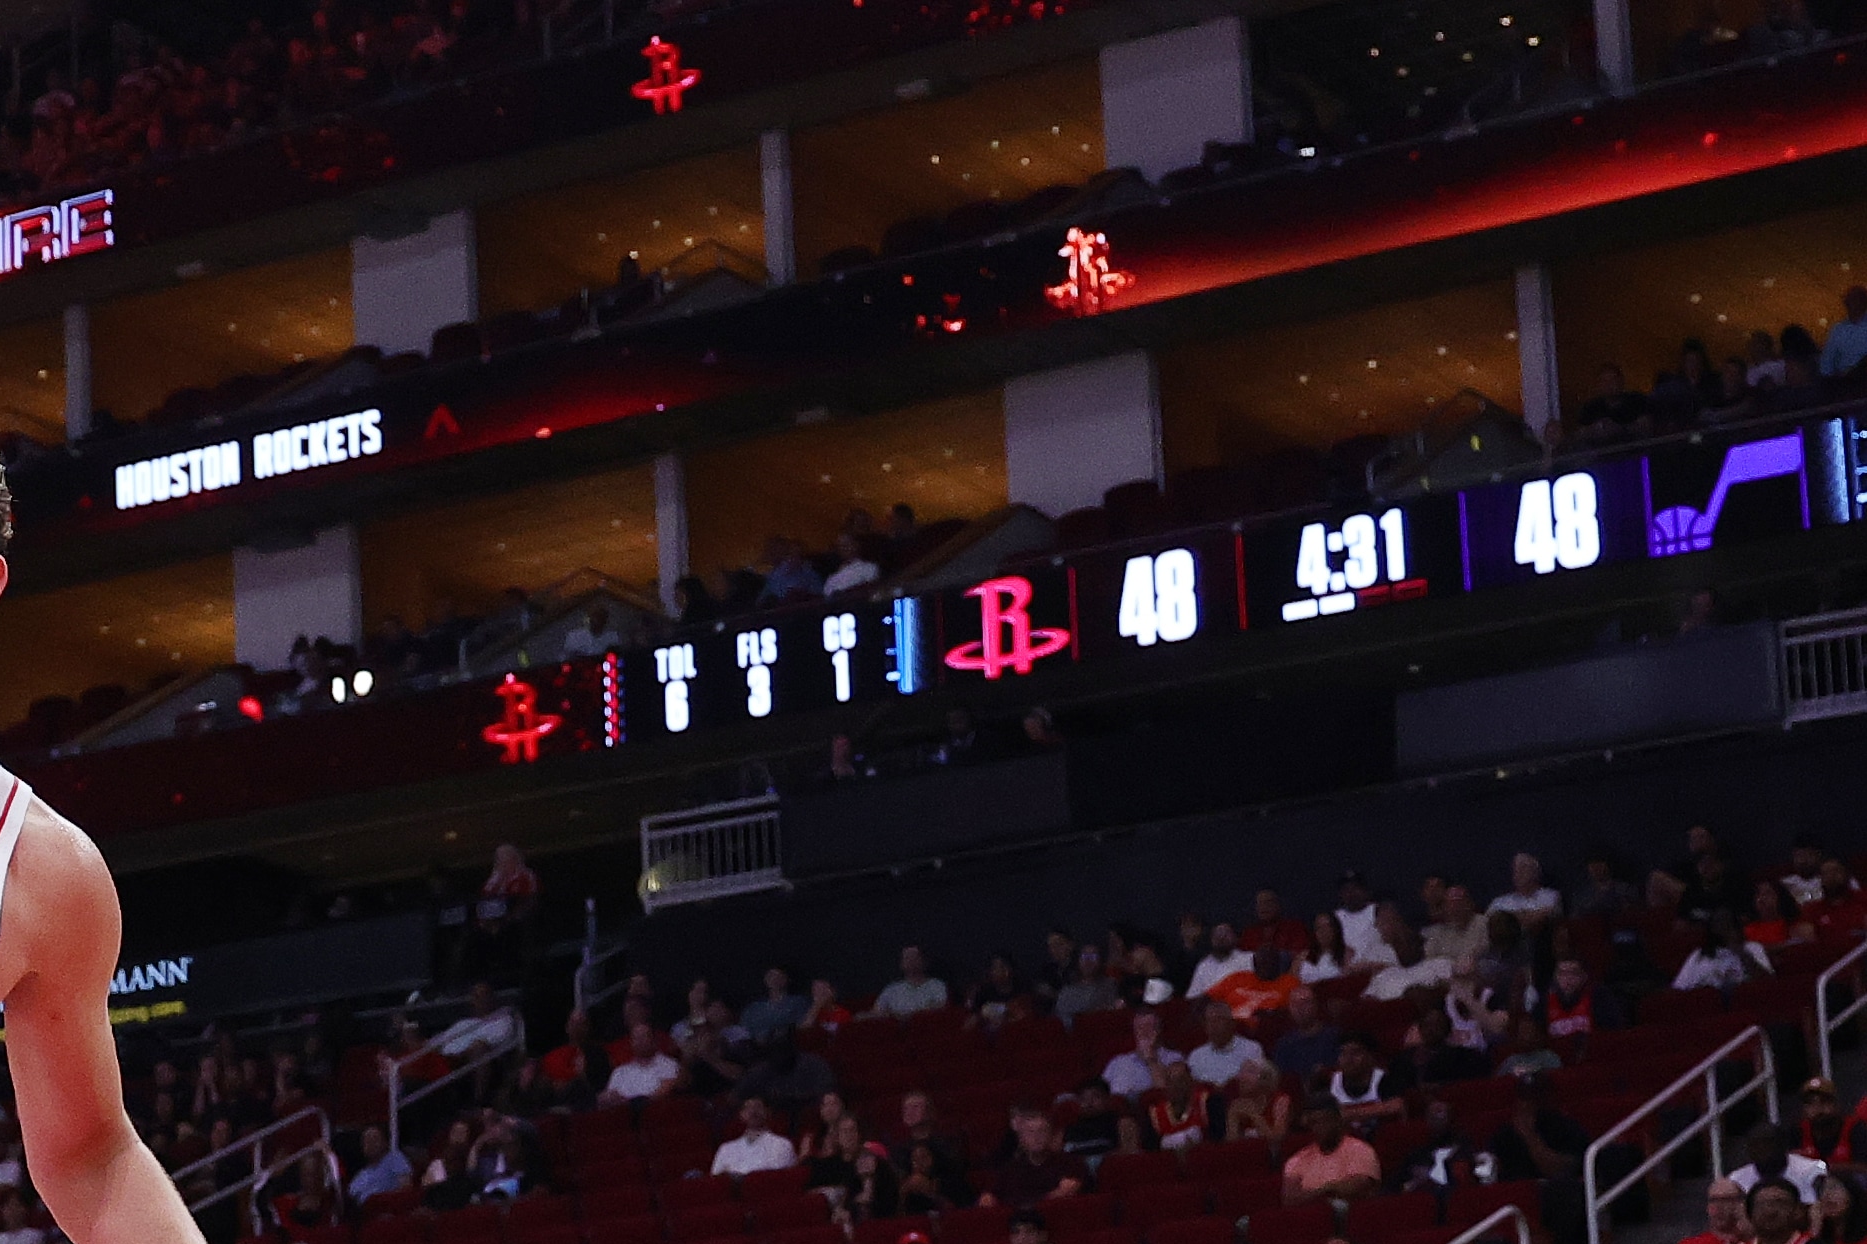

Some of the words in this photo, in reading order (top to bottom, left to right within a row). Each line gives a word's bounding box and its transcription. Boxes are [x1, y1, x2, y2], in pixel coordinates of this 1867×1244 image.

[115, 441, 241, 510] HOUSTON
[253, 409, 382, 479] ROCKETS
[1296, 508, 1407, 596] 4:31
[1514, 472, 1603, 574] 48
[1119, 548, 1199, 647] 48
[654, 643, 697, 684] TOL
[737, 628, 778, 668] FLS
[832, 650, 851, 702] 1
[108, 956, 193, 995] MANN
